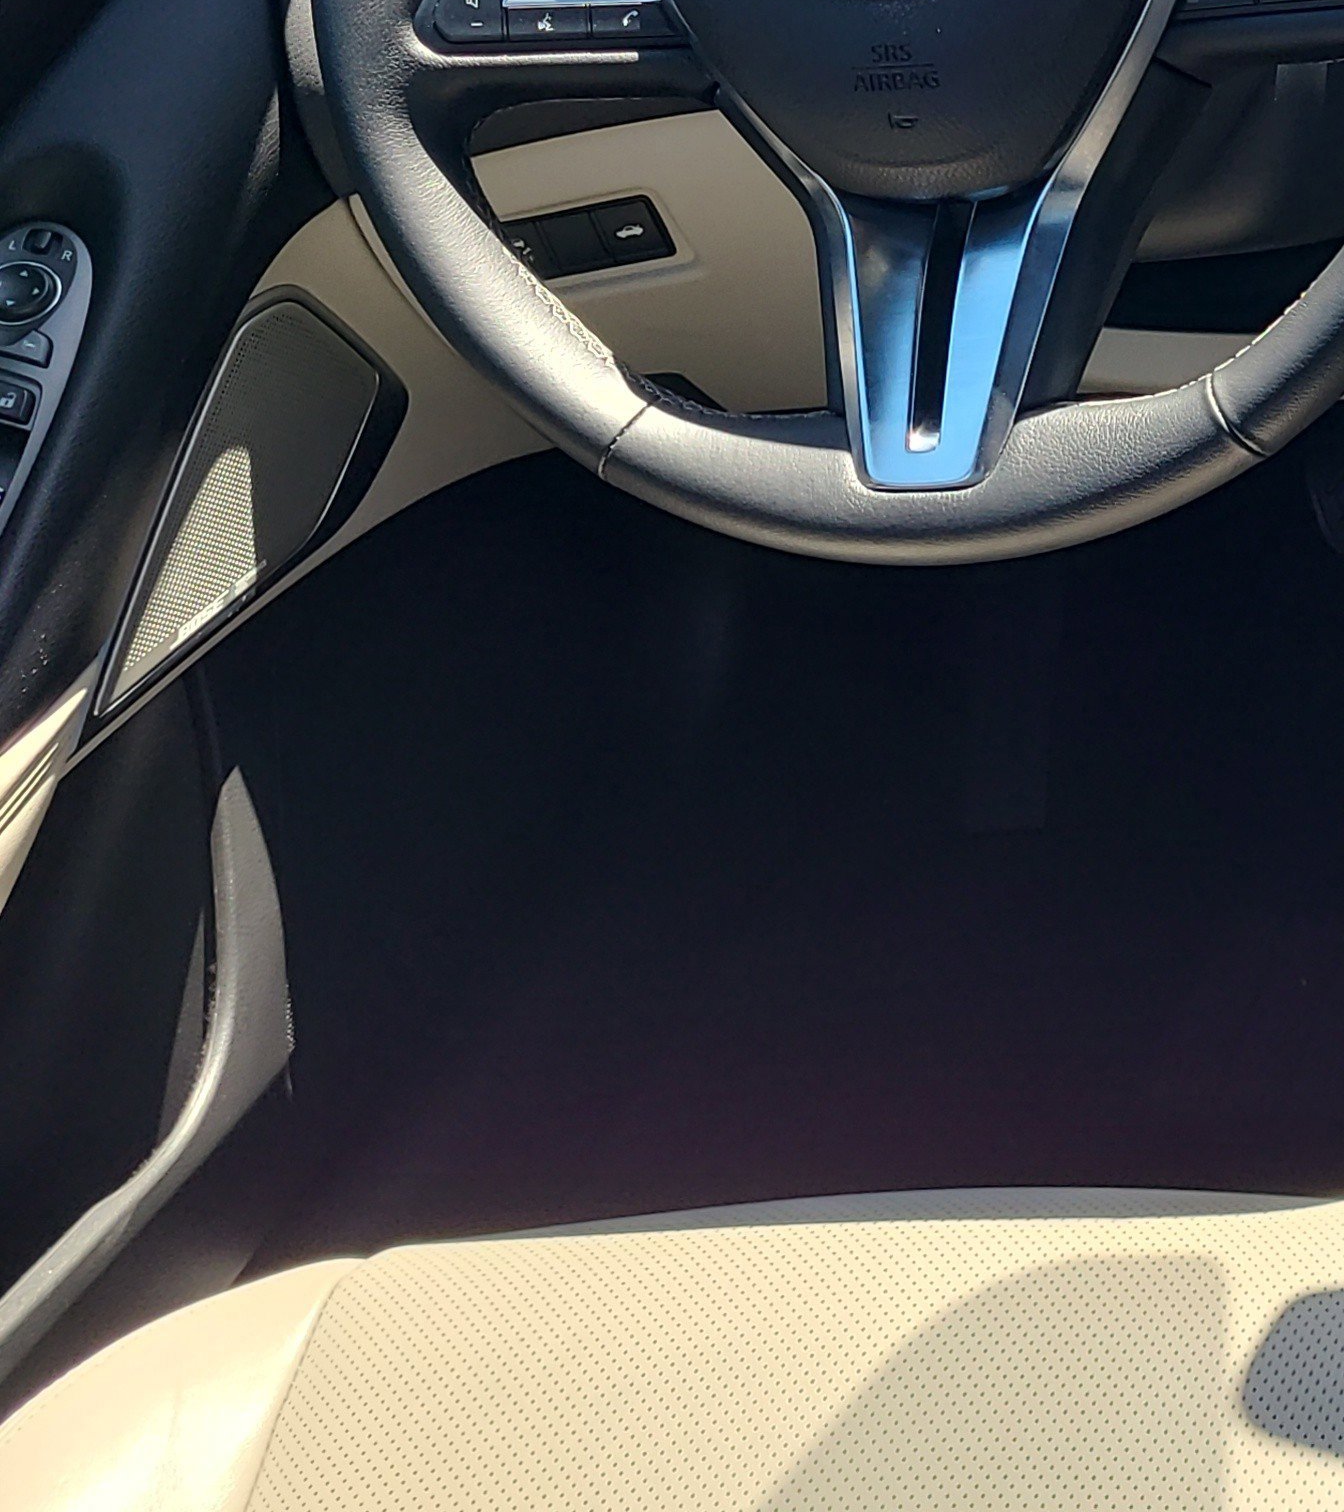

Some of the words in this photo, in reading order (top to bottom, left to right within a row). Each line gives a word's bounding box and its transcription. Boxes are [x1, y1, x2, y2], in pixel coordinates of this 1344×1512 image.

[871, 43, 913, 63] SRS
[854, 71, 940, 91] AIRBAG
[61, 250, 72, 261] R
